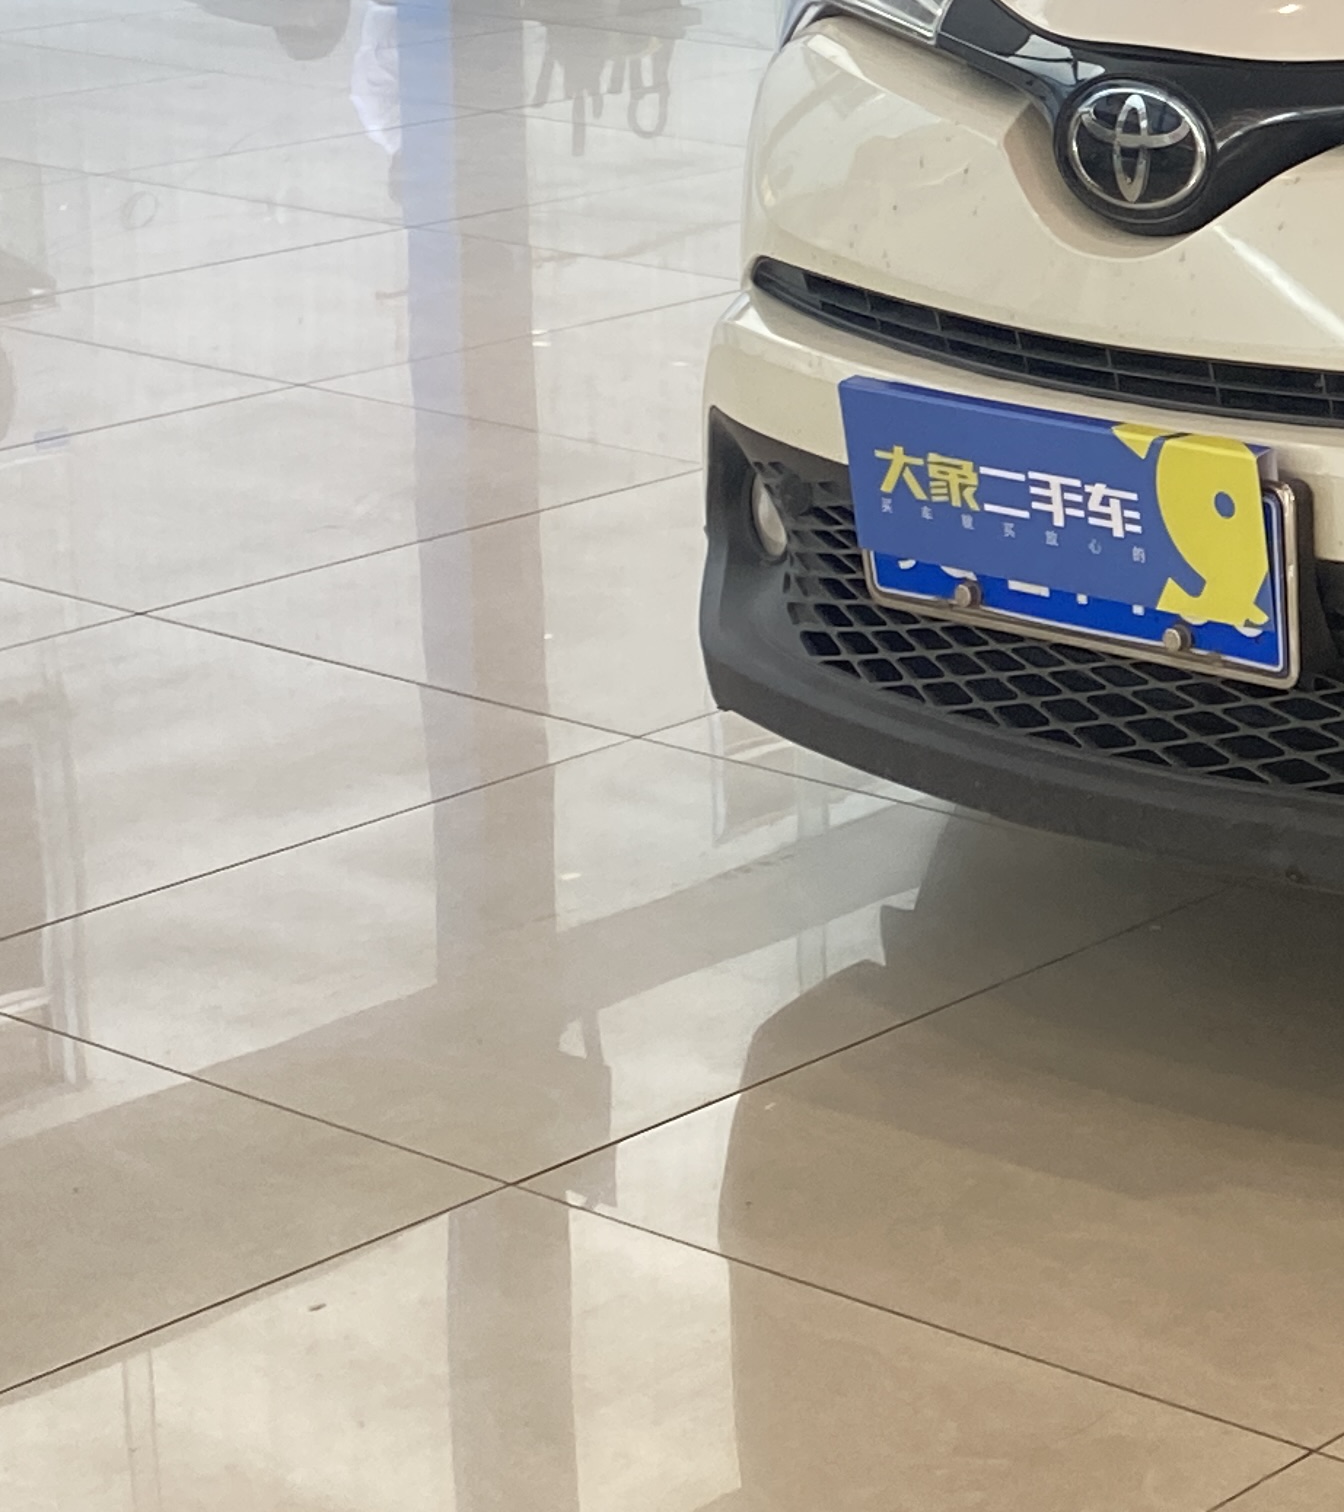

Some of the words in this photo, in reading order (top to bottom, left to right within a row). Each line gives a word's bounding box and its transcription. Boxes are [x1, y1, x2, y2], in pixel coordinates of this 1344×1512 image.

[874, 445, 1143, 539] 大象二手车
